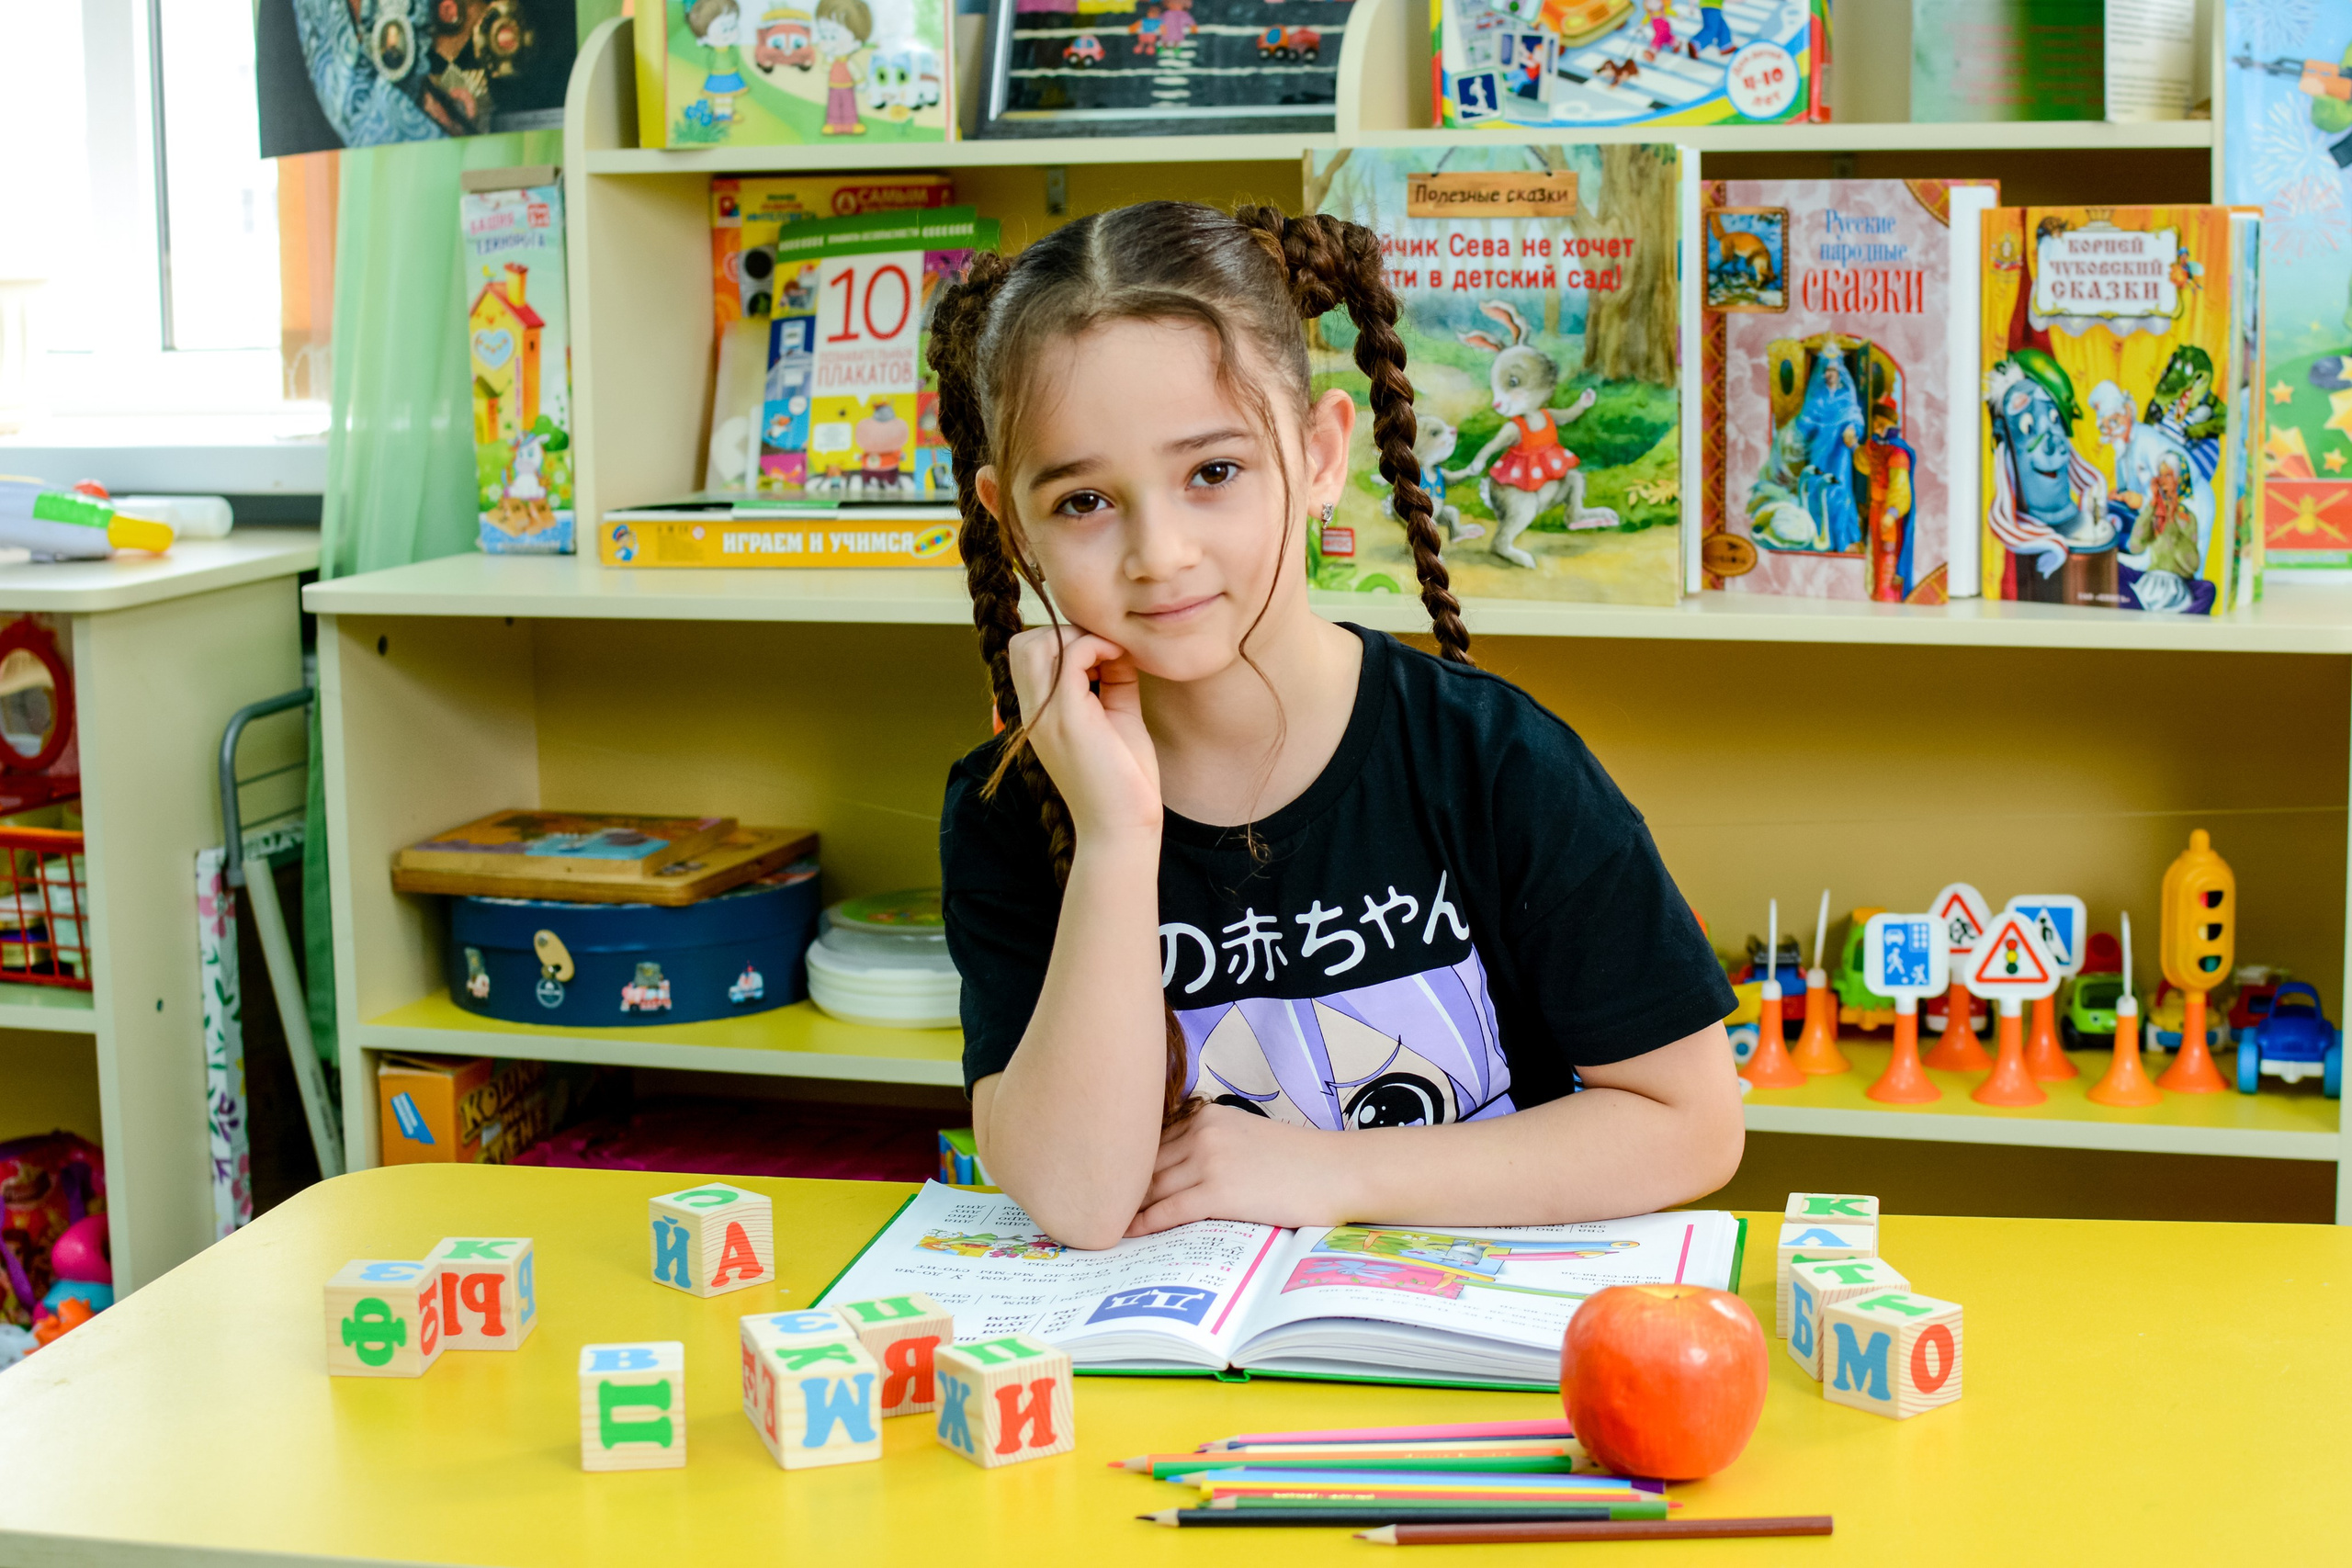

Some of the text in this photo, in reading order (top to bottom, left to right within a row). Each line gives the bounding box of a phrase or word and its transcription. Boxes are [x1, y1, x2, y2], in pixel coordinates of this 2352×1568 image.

[1743, 67, 1783, 89] 4-10
[1414, 185, 1567, 206] Полезные сказки
[1826, 209, 1896, 240] Русские
[1381, 233, 1634, 257] йчик Сева не хочет
[1820, 243, 1907, 267] народные
[2068, 236, 2143, 254] КОРНЕЙ
[1385, 265, 1622, 292] ти в детский сад!
[2050, 259, 2163, 276] ЧУКОВСКИЙ
[827, 263, 910, 344] 10
[2052, 281, 2159, 301] СКАЗКИ
[818, 360, 913, 387] ПЛАКАТОВ
[722, 532, 804, 554] ИГРАЕМ
[809, 532, 823, 553] И
[829, 531, 914, 554] УЧИМСЯ
[1158, 869, 1471, 994] の赤ちゃん
[1803, 1197, 1871, 1216] К
[442, 1240, 517, 1259] К
[652, 1215, 692, 1289] Й
[711, 1222, 763, 1288] А
[894, 1268, 944, 1277] до-ма
[1813, 1263, 1875, 1284] Т
[342, 1297, 406, 1367] Ф
[1792, 1280, 1814, 1359] Б
[587, 1348, 660, 1372] В
[952, 1337, 1045, 1365] П
[1833, 1322, 1892, 1401] М
[1910, 1324, 1955, 1394] О
[880, 1335, 941, 1409] Я
[936, 1370, 975, 1454] Ж
[994, 1377, 1057, 1455] И
